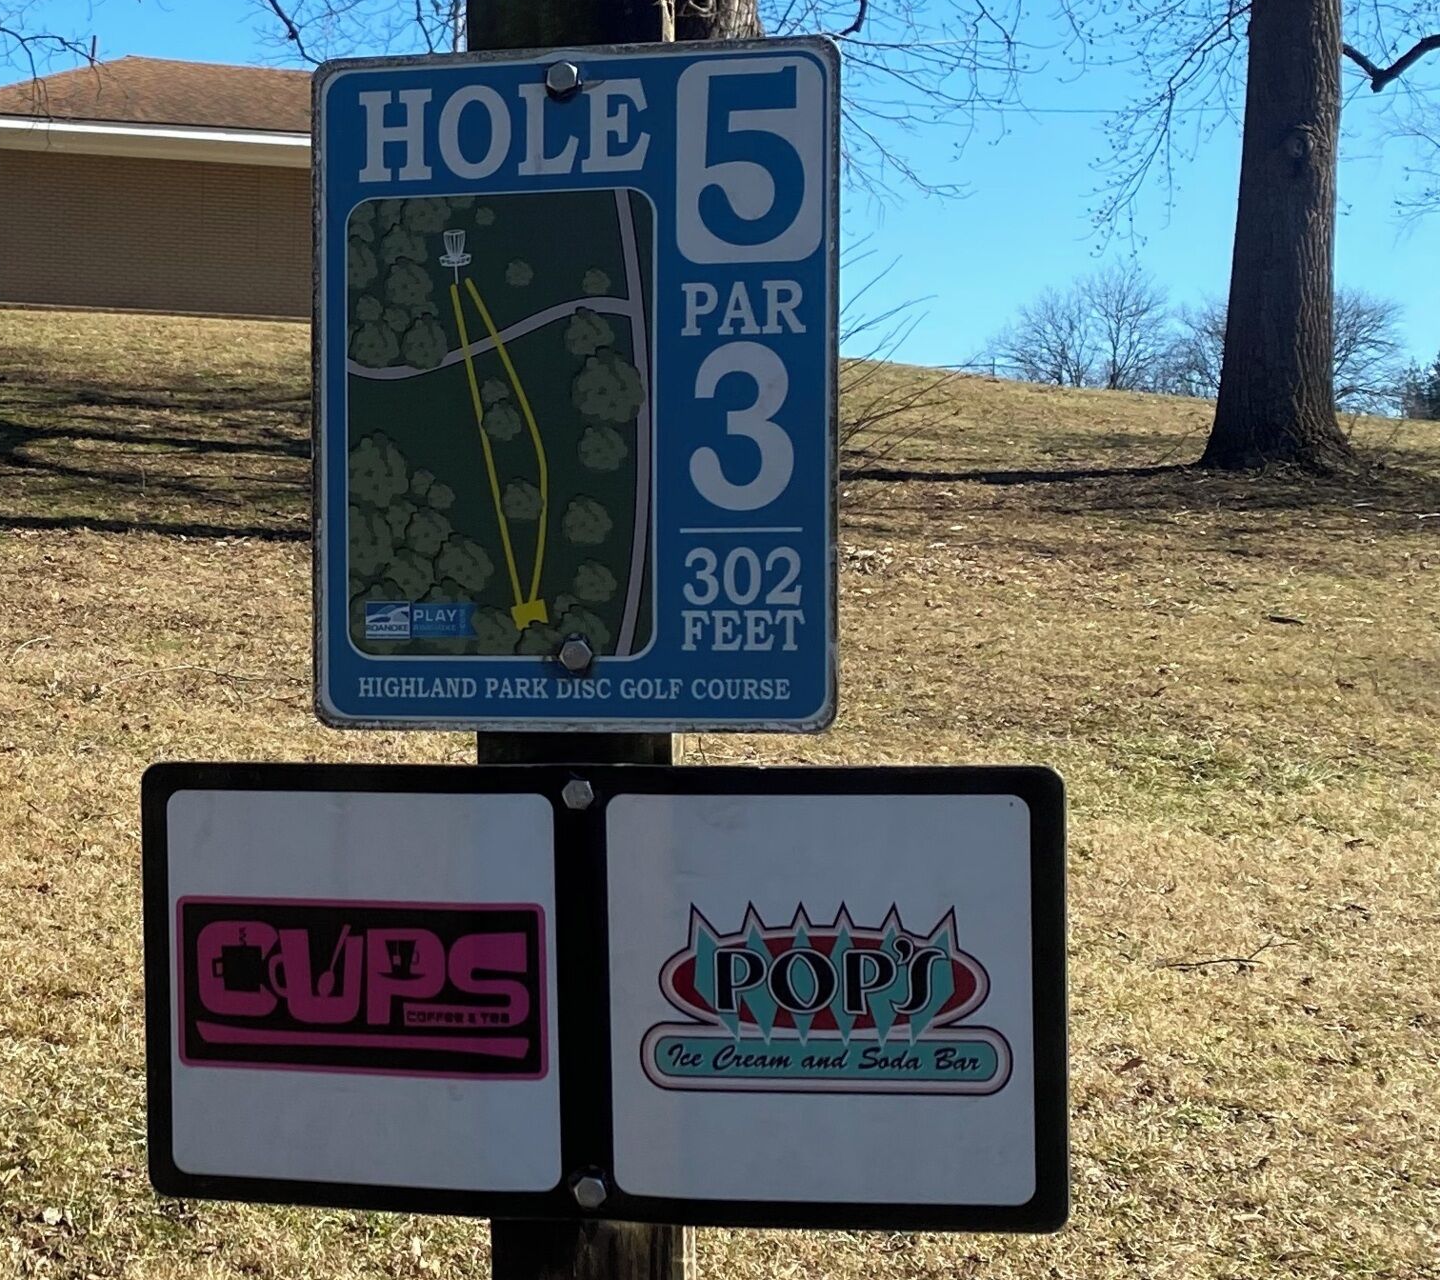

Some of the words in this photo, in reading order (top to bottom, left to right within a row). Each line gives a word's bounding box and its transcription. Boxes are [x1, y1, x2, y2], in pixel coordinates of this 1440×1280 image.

[358, 77, 651, 183] HOLE
[697, 64, 806, 246] 5
[680, 279, 807, 337] PAR
[688, 340, 795, 512] 3
[682, 546, 803, 607] 302
[365, 624, 409, 632] ROANOKE
[413, 609, 457, 622] PLAY
[680, 608, 806, 652] FEET
[358, 676, 477, 699] HIGHLAND
[484, 677, 549, 700] PARK
[555, 677, 612, 700] DISC
[619, 678, 684, 700] GOLF
[691, 678, 791, 701] COURSE
[196, 920, 530, 1026] CUPS
[714, 935, 950, 1015] POP'S
[667, 1042, 704, 1068] Ice
[711, 1044, 792, 1071] Cream
[800, 1047, 851, 1070] and
[857, 1046, 923, 1071] Soda
[933, 1047, 981, 1072] Bar
